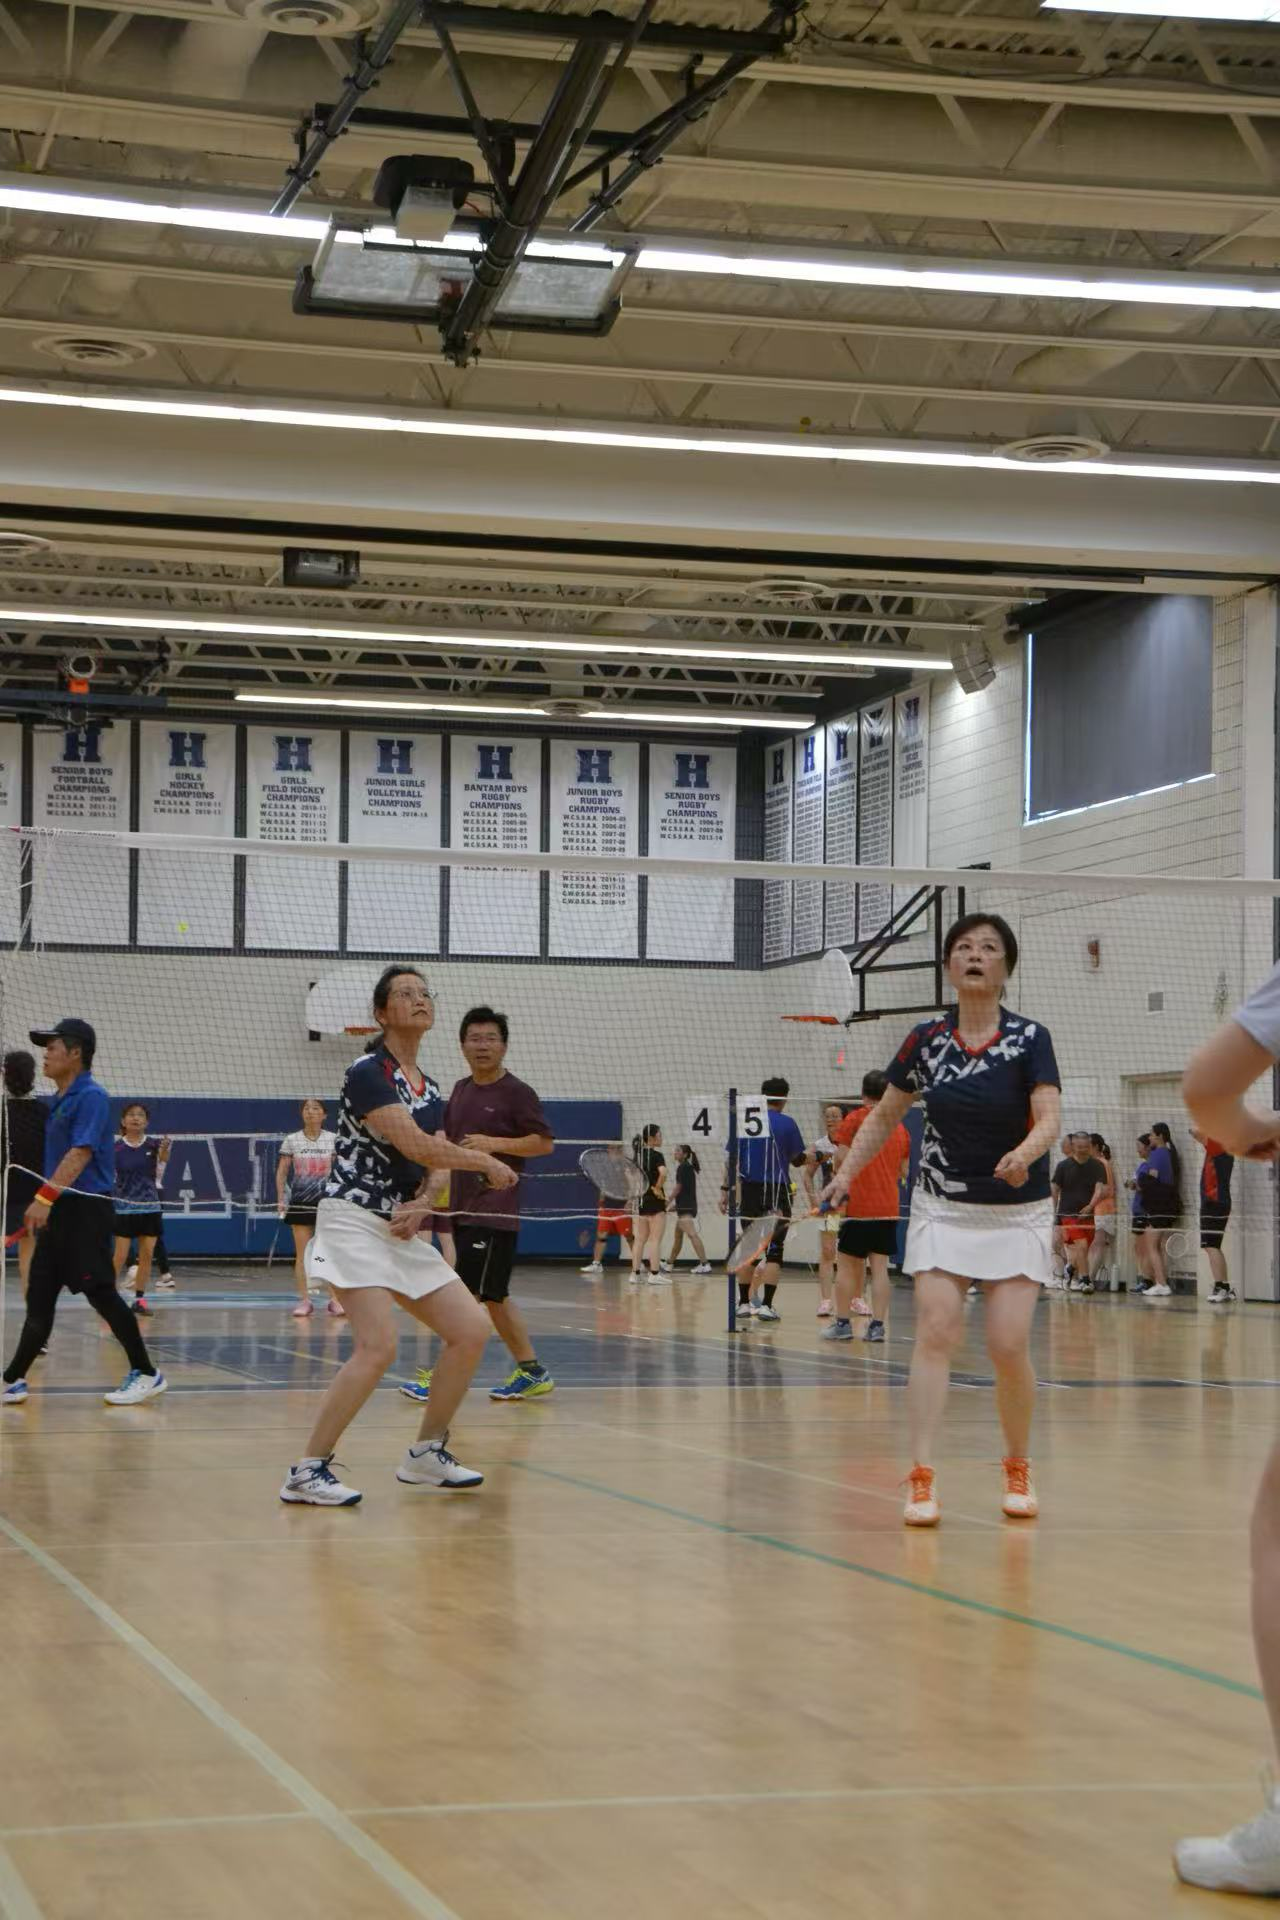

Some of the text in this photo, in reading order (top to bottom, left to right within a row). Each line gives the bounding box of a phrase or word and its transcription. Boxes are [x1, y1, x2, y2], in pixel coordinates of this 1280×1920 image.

[63, 727, 101, 762] H
[169, 731, 206, 767] H
[275, 736, 312, 771] H
[377, 739, 414, 774] H
[804, 736, 815, 773] H
[478, 745, 513, 780] H
[576, 749, 612, 783] H
[51, 766, 113, 776] SENIOR BOYS
[675, 754, 710, 788] H
[57, 776, 105, 784] FOOTBALL
[175, 773, 202, 781] GIRLS
[364, 778, 397, 786] JUNIOR
[53, 784, 110, 794] CHAMPIONS
[170, 781, 205, 790] HOCKEY
[262, 784, 325, 794] FIELD HOCKEY
[464, 784, 528, 793] BANTAM BOYS
[160, 789, 214, 799] CHAMPIONS
[267, 793, 320, 802] CHAMPIONS
[367, 788, 422, 798] VOLLEYBALL
[567, 788, 623, 797] JUNIOR BOYS
[664, 792, 720, 801] SENIOR BOYS
[368, 799, 421, 808] CHAMPIONS
[470, 801, 522, 810] CHAMPIONS
[678, 801, 706, 809] RUGBY
[569, 805, 620, 814] CHAMPIONS
[667, 809, 718, 818] CHAMPIONS
[692, 1107, 712, 1136] 4
[745, 1107, 763, 1136] 5
